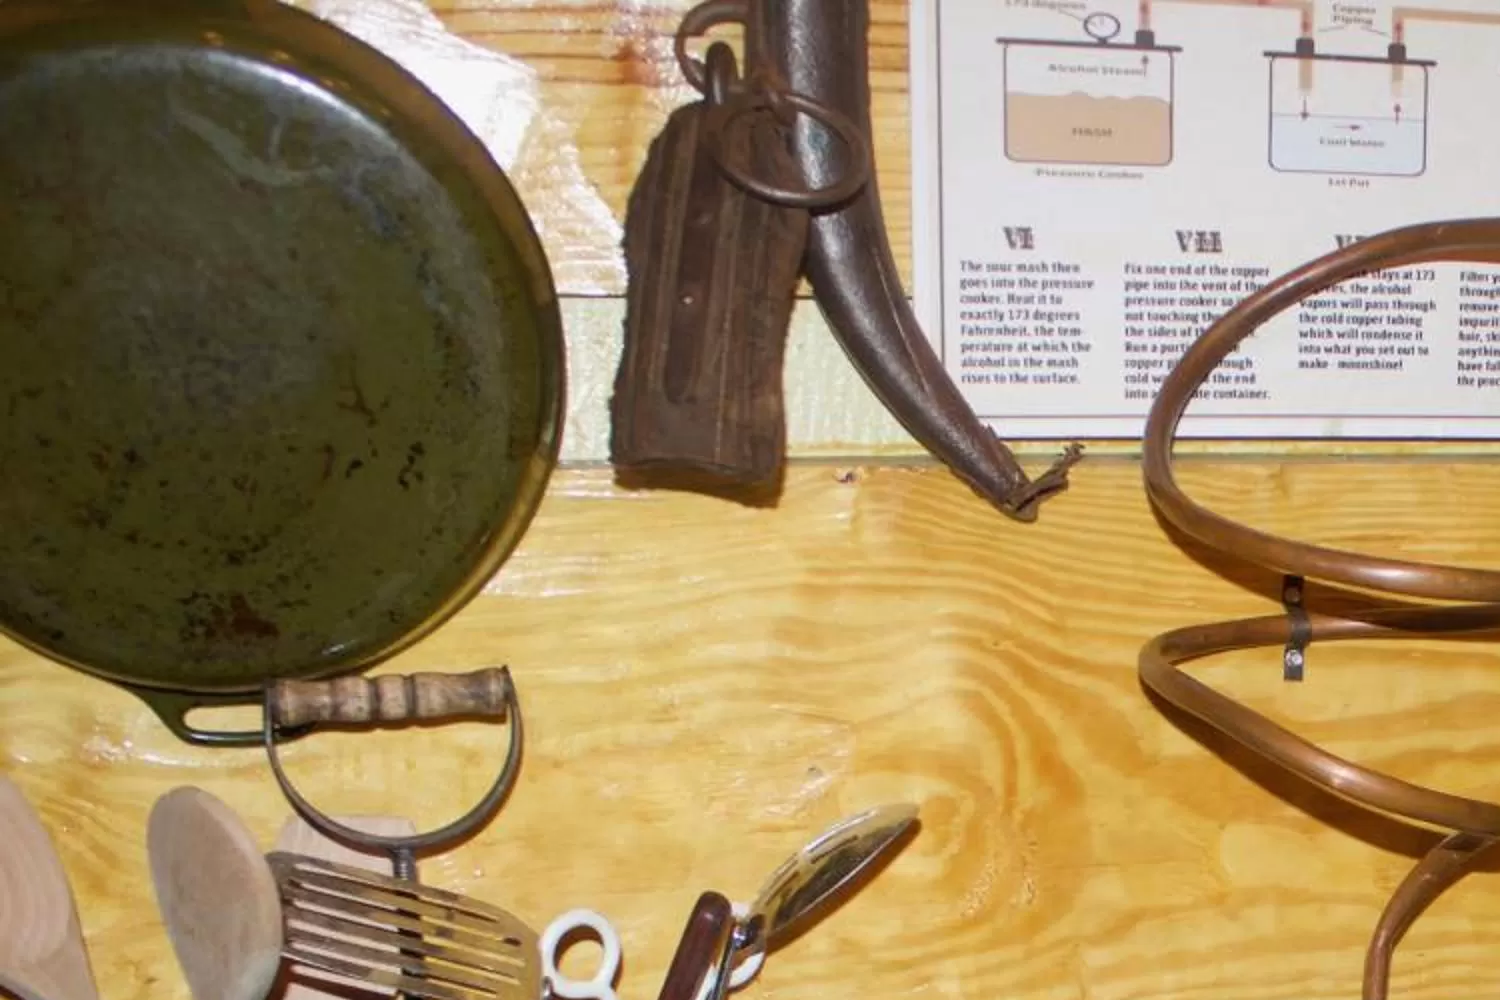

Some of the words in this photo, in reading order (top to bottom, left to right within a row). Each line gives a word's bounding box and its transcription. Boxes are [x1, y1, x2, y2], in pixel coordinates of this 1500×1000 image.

[960, 261, 982, 272] The
[986, 263, 1012, 272] sour
[1016, 261, 1049, 272] mash
[1052, 261, 1080, 272] then
[1125, 263, 1142, 275] Fix
[1146, 265, 1166, 275] one
[1170, 263, 1192, 275] end
[1195, 263, 1206, 275] of
[1209, 264, 1228, 275] the
[1231, 266, 1269, 277] copper
[1402, 271, 1413, 281] at
[1416, 269, 1435, 280] 173
[1460, 271, 1489, 282] Filter
[960, 278, 988, 290] goes
[991, 278, 1015, 288] into
[1019, 278, 1038, 288] the
[1041, 280, 1094, 290] pressure
[1125, 280, 1149, 291] pipe
[1153, 280, 1176, 291] into
[1179, 280, 1198, 291] the
[1201, 280, 1226, 291] vent
[1230, 280, 1241, 291] of
[1350, 283, 1368, 294] the
[1372, 284, 1411, 295] alcohol
[1038, 293, 1046, 304] it
[1051, 293, 1063, 304] to
[1125, 295, 1175, 307] pressure
[1179, 295, 1217, 307] cooker
[1221, 297, 1233, 307] so
[1341, 300, 1362, 308] will
[1365, 301, 1389, 311] pass
[1392, 300, 1436, 312] through
[1459, 303, 1499, 312] remove
[960, 309, 1004, 322] exactly
[1008, 309, 1029, 321] 173
[1032, 309, 1080, 322] degrees
[1125, 311, 1144, 323] not
[1148, 311, 1198, 323] touching
[1299, 312, 1318, 324] the
[1321, 313, 1343, 324] cold
[1346, 314, 1382, 326] copper
[1387, 314, 1422, 328] tubing
[1034, 325, 1054, 336] the
[1125, 327, 1144, 337] the
[1148, 327, 1177, 337] sides
[1180, 327, 1192, 337] of
[1299, 328, 1333, 339] which
[1337, 328, 1359, 339] will
[1361, 328, 1412, 340] condense
[1416, 331, 1423, 340] it
[961, 342, 1013, 353] perature
[1017, 342, 1028, 351] at
[1032, 342, 1068, 352] which
[1072, 341, 1091, 352] the
[1125, 342, 1148, 352] Run
[1299, 344, 1321, 354] into
[1324, 344, 1351, 354] what
[1355, 344, 1375, 356] you
[1378, 344, 1394, 354] set
[1398, 344, 1414, 354] out
[1418, 346, 1429, 355] to
[961, 357, 1005, 368] alcohol
[1008, 357, 1020, 368] in
[1024, 357, 1043, 368] the
[1047, 357, 1079, 368] mash
[1125, 359, 1164, 369] copper
[1299, 359, 1328, 368] make
[1458, 361, 1482, 371] have
[961, 373, 990, 384] rises
[994, 373, 1006, 384] to
[1010, 373, 1028, 384] the
[1125, 374, 1148, 383] cold
[1213, 374, 1232, 383] the
[1235, 374, 1256, 383] end
[1458, 376, 1474, 386] the
[1125, 389, 1148, 399] into
